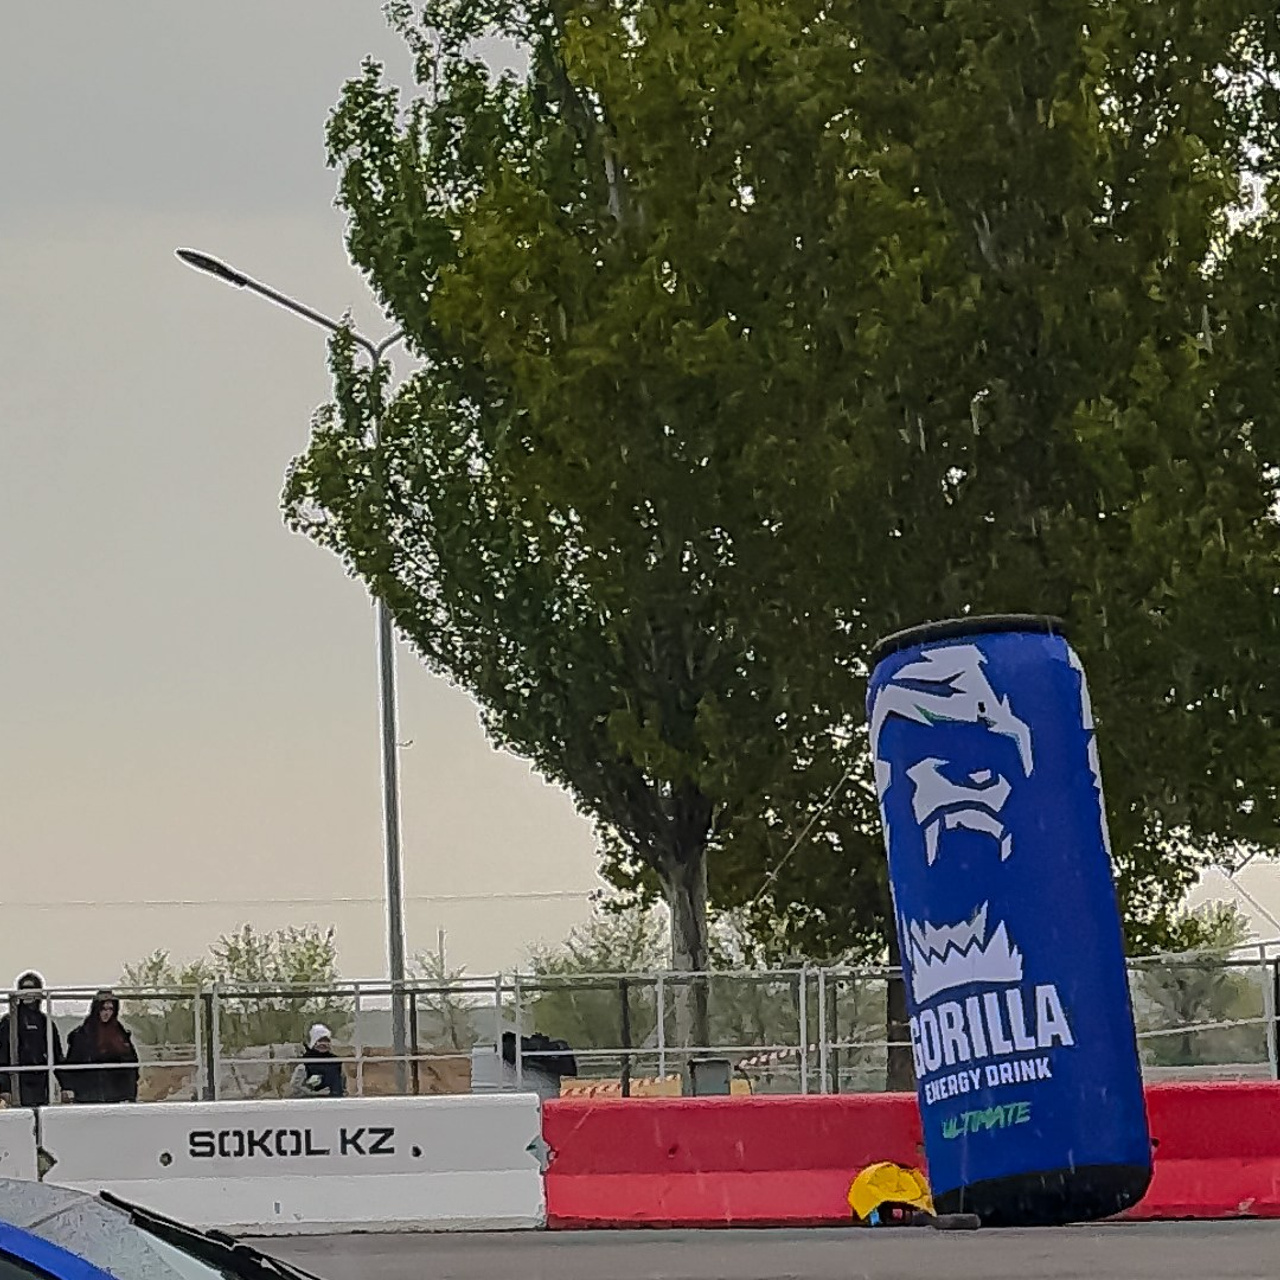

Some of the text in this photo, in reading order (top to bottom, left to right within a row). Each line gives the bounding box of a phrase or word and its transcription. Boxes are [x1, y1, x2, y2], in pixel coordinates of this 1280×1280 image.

[924, 1056, 1054, 1106] ENERGY DRINK
[941, 1101, 1033, 1141] ULTIMATE
[188, 1127, 395, 1158] SOKOL KZ
